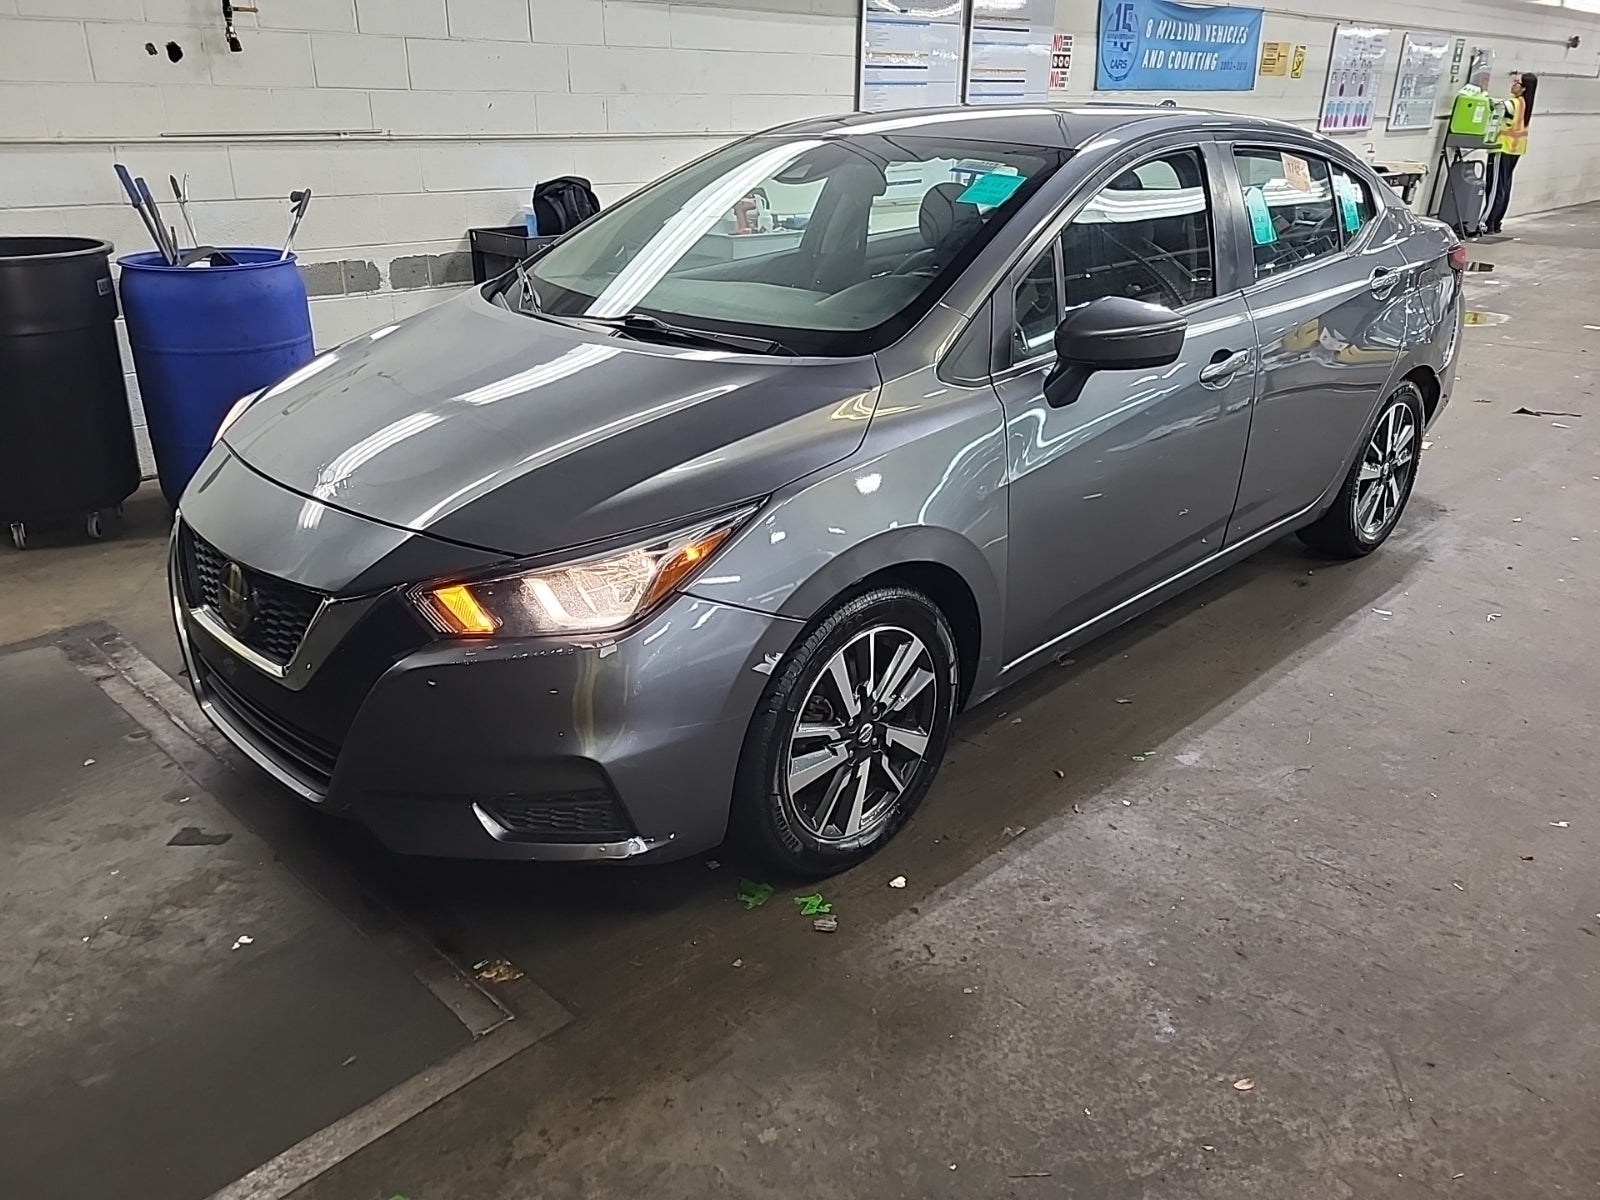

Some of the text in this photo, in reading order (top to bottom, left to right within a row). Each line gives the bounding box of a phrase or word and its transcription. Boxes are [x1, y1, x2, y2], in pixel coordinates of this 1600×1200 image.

[1145, 19, 1249, 44] 8 MILLION VEHICLES
[1053, 34, 1063, 52] NO
[1110, 59, 1128, 70] CARS
[1142, 49, 1163, 71] AND
[1168, 51, 1219, 71] COUNTING
[1050, 71, 1060, 88] NO
